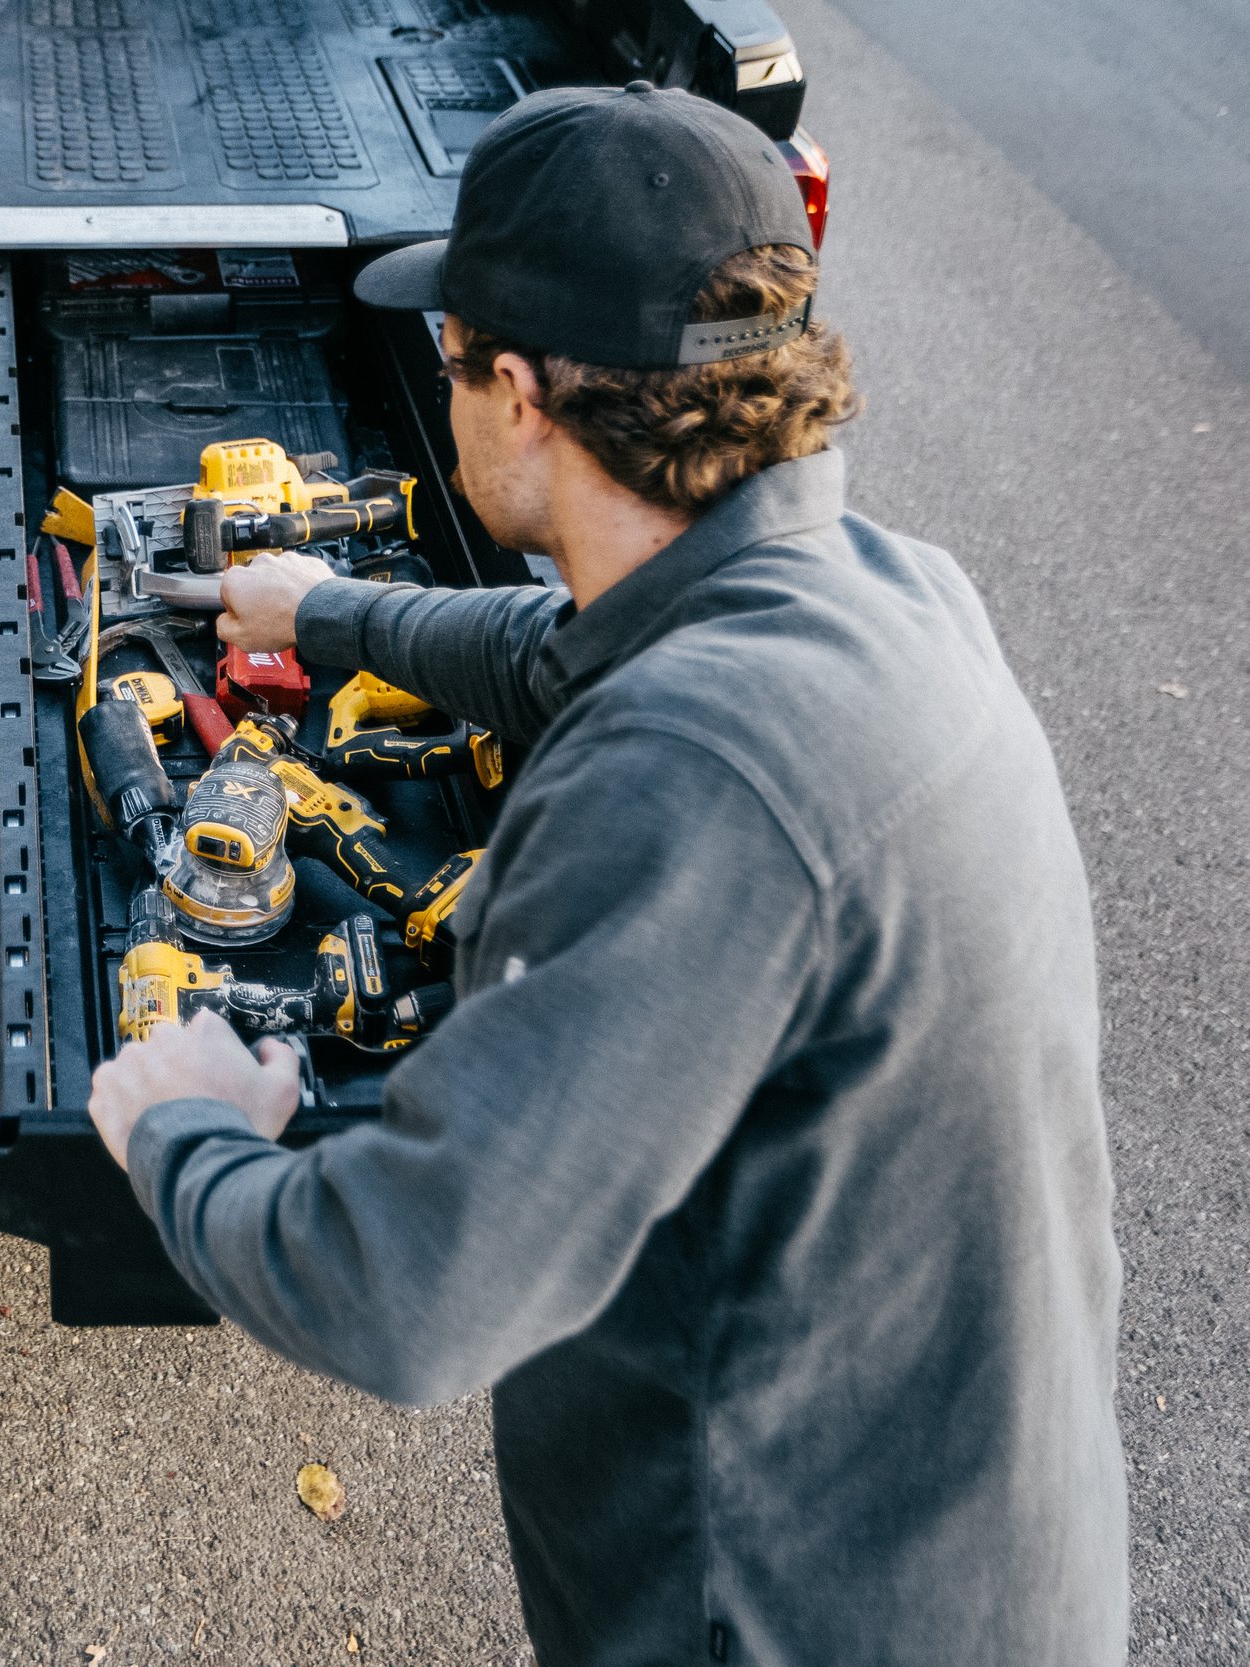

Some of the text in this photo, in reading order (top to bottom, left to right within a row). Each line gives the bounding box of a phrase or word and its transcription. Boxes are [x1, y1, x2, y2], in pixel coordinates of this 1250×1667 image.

[132, 678, 154, 704] DEWALT
[222, 780, 260, 800] XR
[153, 819, 166, 849] DEWALT
